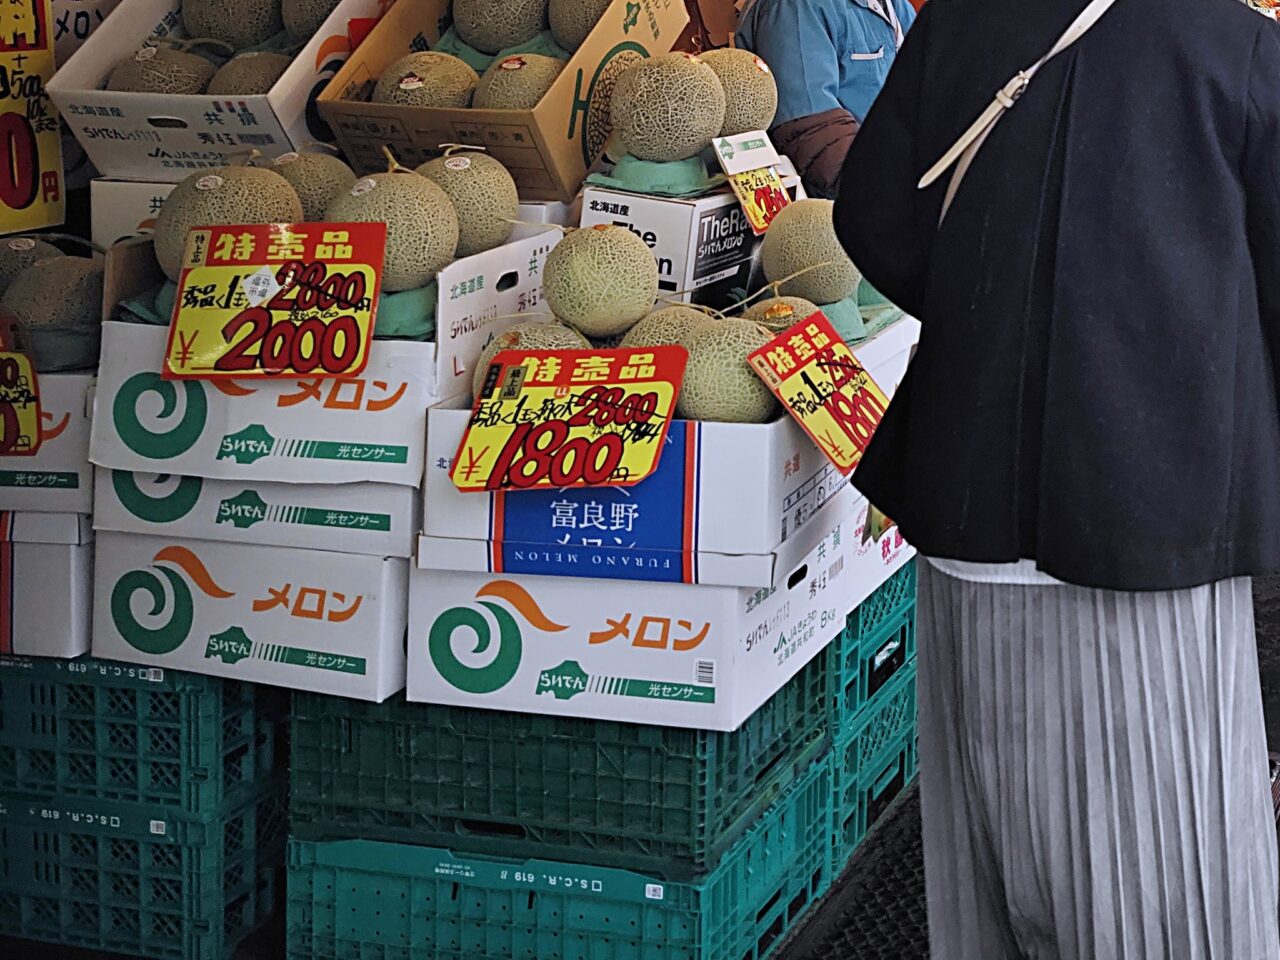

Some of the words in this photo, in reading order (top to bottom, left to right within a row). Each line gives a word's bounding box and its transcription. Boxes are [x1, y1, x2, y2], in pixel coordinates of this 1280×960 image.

[41, 170, 59, 204] 円
[590, 199, 630, 216] 北海道産
[214, 231, 353, 260] 特売品
[449, 275, 485, 300] 北海道産
[175, 329, 199, 369] ¥
[213, 306, 361, 375] 2000
[765, 323, 831, 375] 特売品
[523, 352, 656, 382] 特売品
[276, 379, 408, 412] メロン
[221, 437, 272, 455] らいでん
[337, 444, 397, 459] 光センサー
[460, 446, 489, 482] ¥
[14, 472, 69, 486] 光センサー
[219, 502, 266, 520] らいでん
[324, 512, 381, 527] 光センサー
[549, 499, 640, 532] 富良野
[514, 550, 578, 564] MELON
[592, 555, 671, 569] FURANO
[252, 583, 363, 623] メロン
[588, 612, 712, 652] メロン
[68, 661, 87, 673] 619
[208, 637, 251, 656] らいでん
[304, 652, 358, 669] 光センサー
[540, 671, 586, 691] らいでん
[648, 682, 705, 699] 光センサー
[41, 807, 59, 819] 619
[514, 871, 535, 883] 619
[542, 873, 588, 889] S.C.R.
